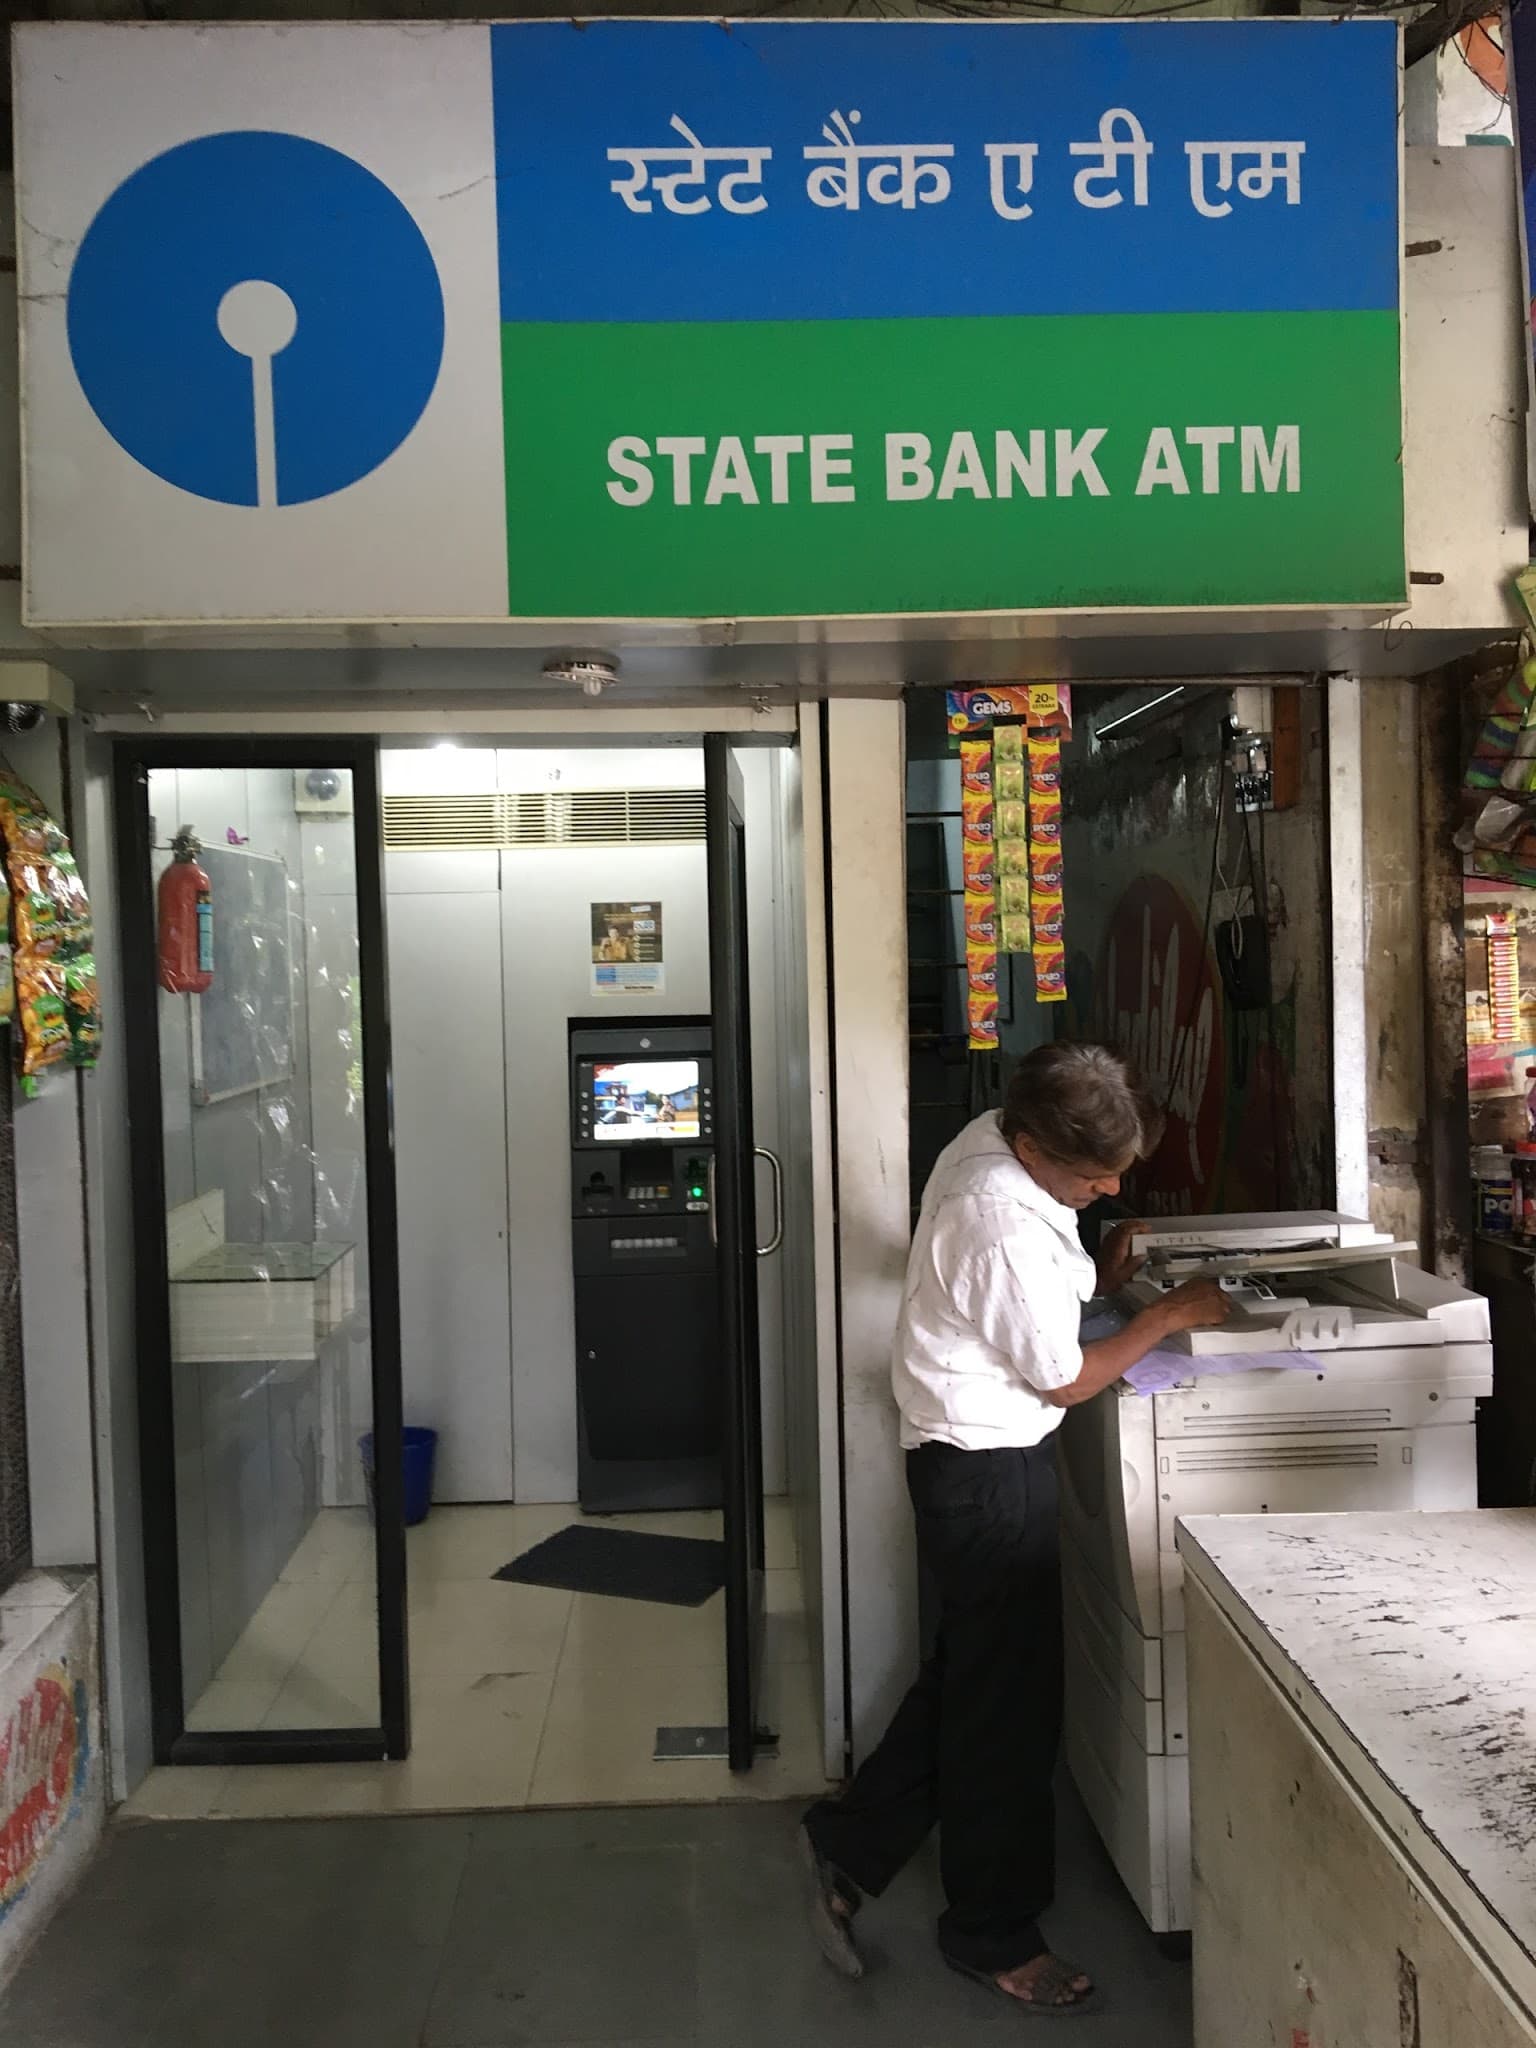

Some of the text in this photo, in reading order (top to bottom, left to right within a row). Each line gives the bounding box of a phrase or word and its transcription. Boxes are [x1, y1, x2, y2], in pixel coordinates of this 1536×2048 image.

[607, 108, 1306, 221] स्टेट बैंक ए टी एम
[606, 424, 1302, 507] STATE BANK ATM
[972, 701, 1011, 715] GEMS
